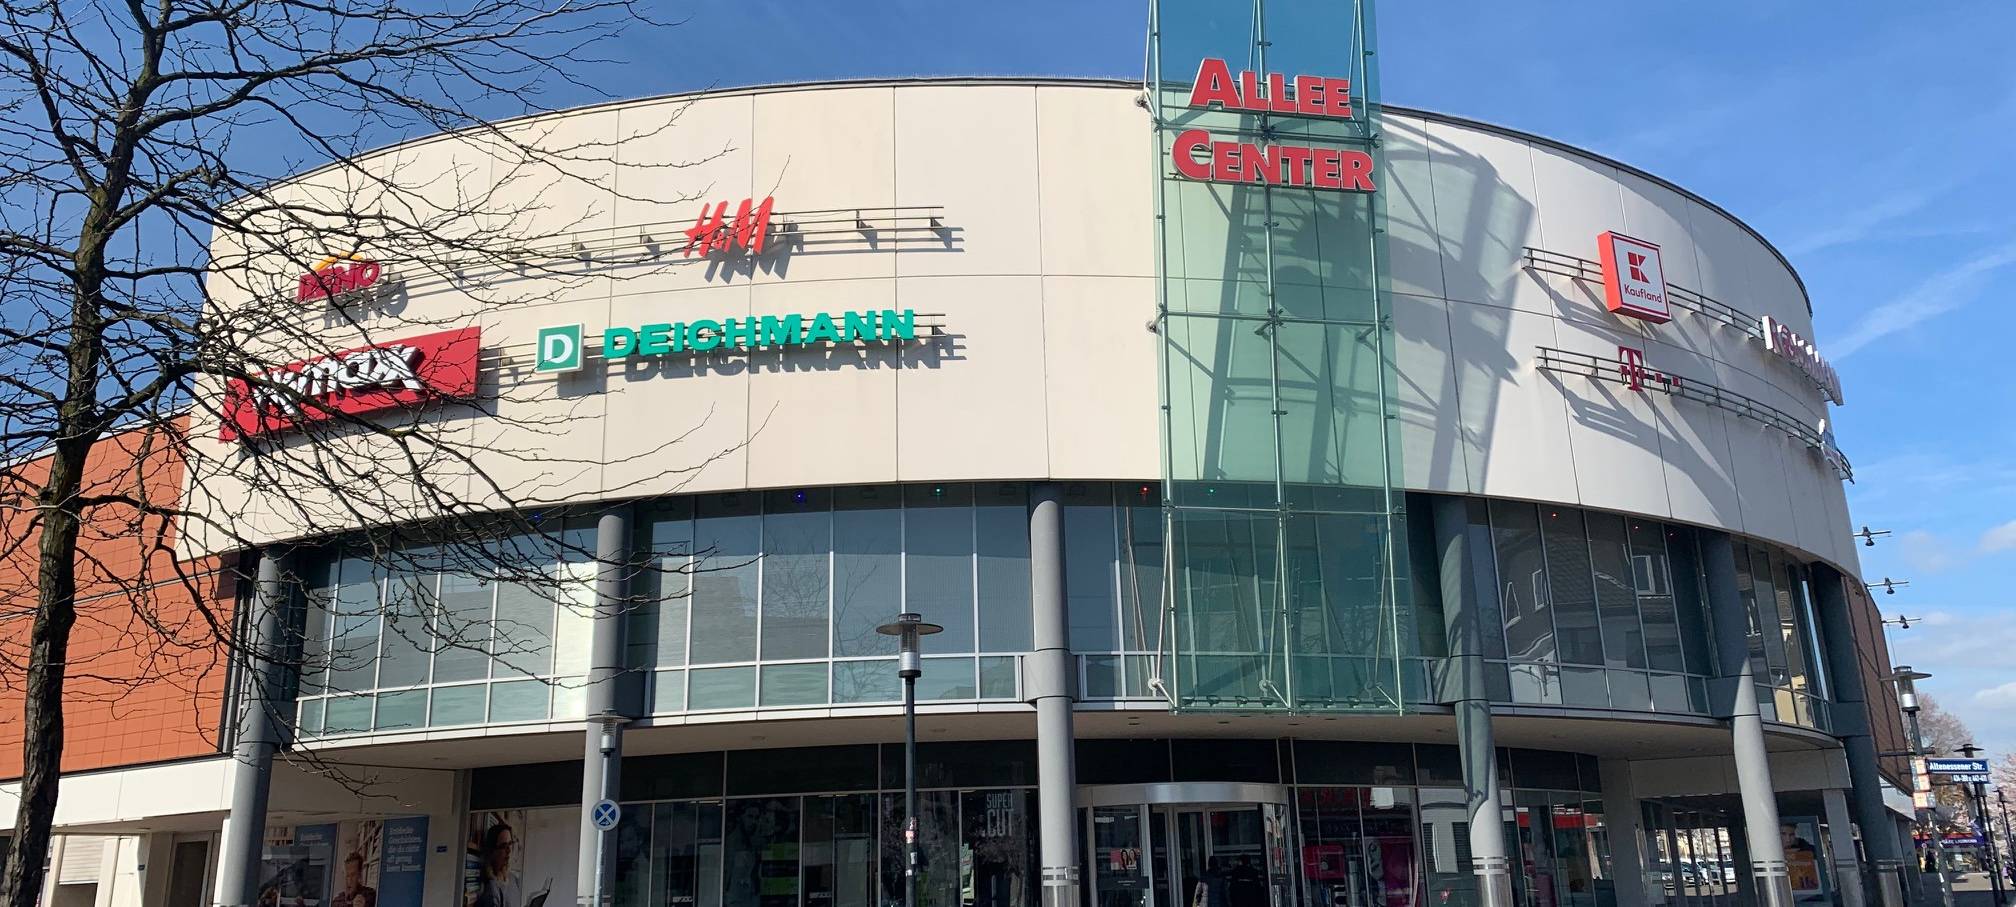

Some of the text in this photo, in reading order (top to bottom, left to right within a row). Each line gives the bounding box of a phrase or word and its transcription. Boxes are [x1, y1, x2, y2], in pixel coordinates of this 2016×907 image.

[1189, 58, 1352, 118] ALLEE
[1172, 128, 1376, 191] CENTER
[683, 196, 775, 258] H&M
[1624, 284, 1662, 304] Kaufland
[543, 309, 914, 365] D DEICHMANN
[987, 792, 1012, 808] SUPER
[988, 809, 1014, 837] CUT
